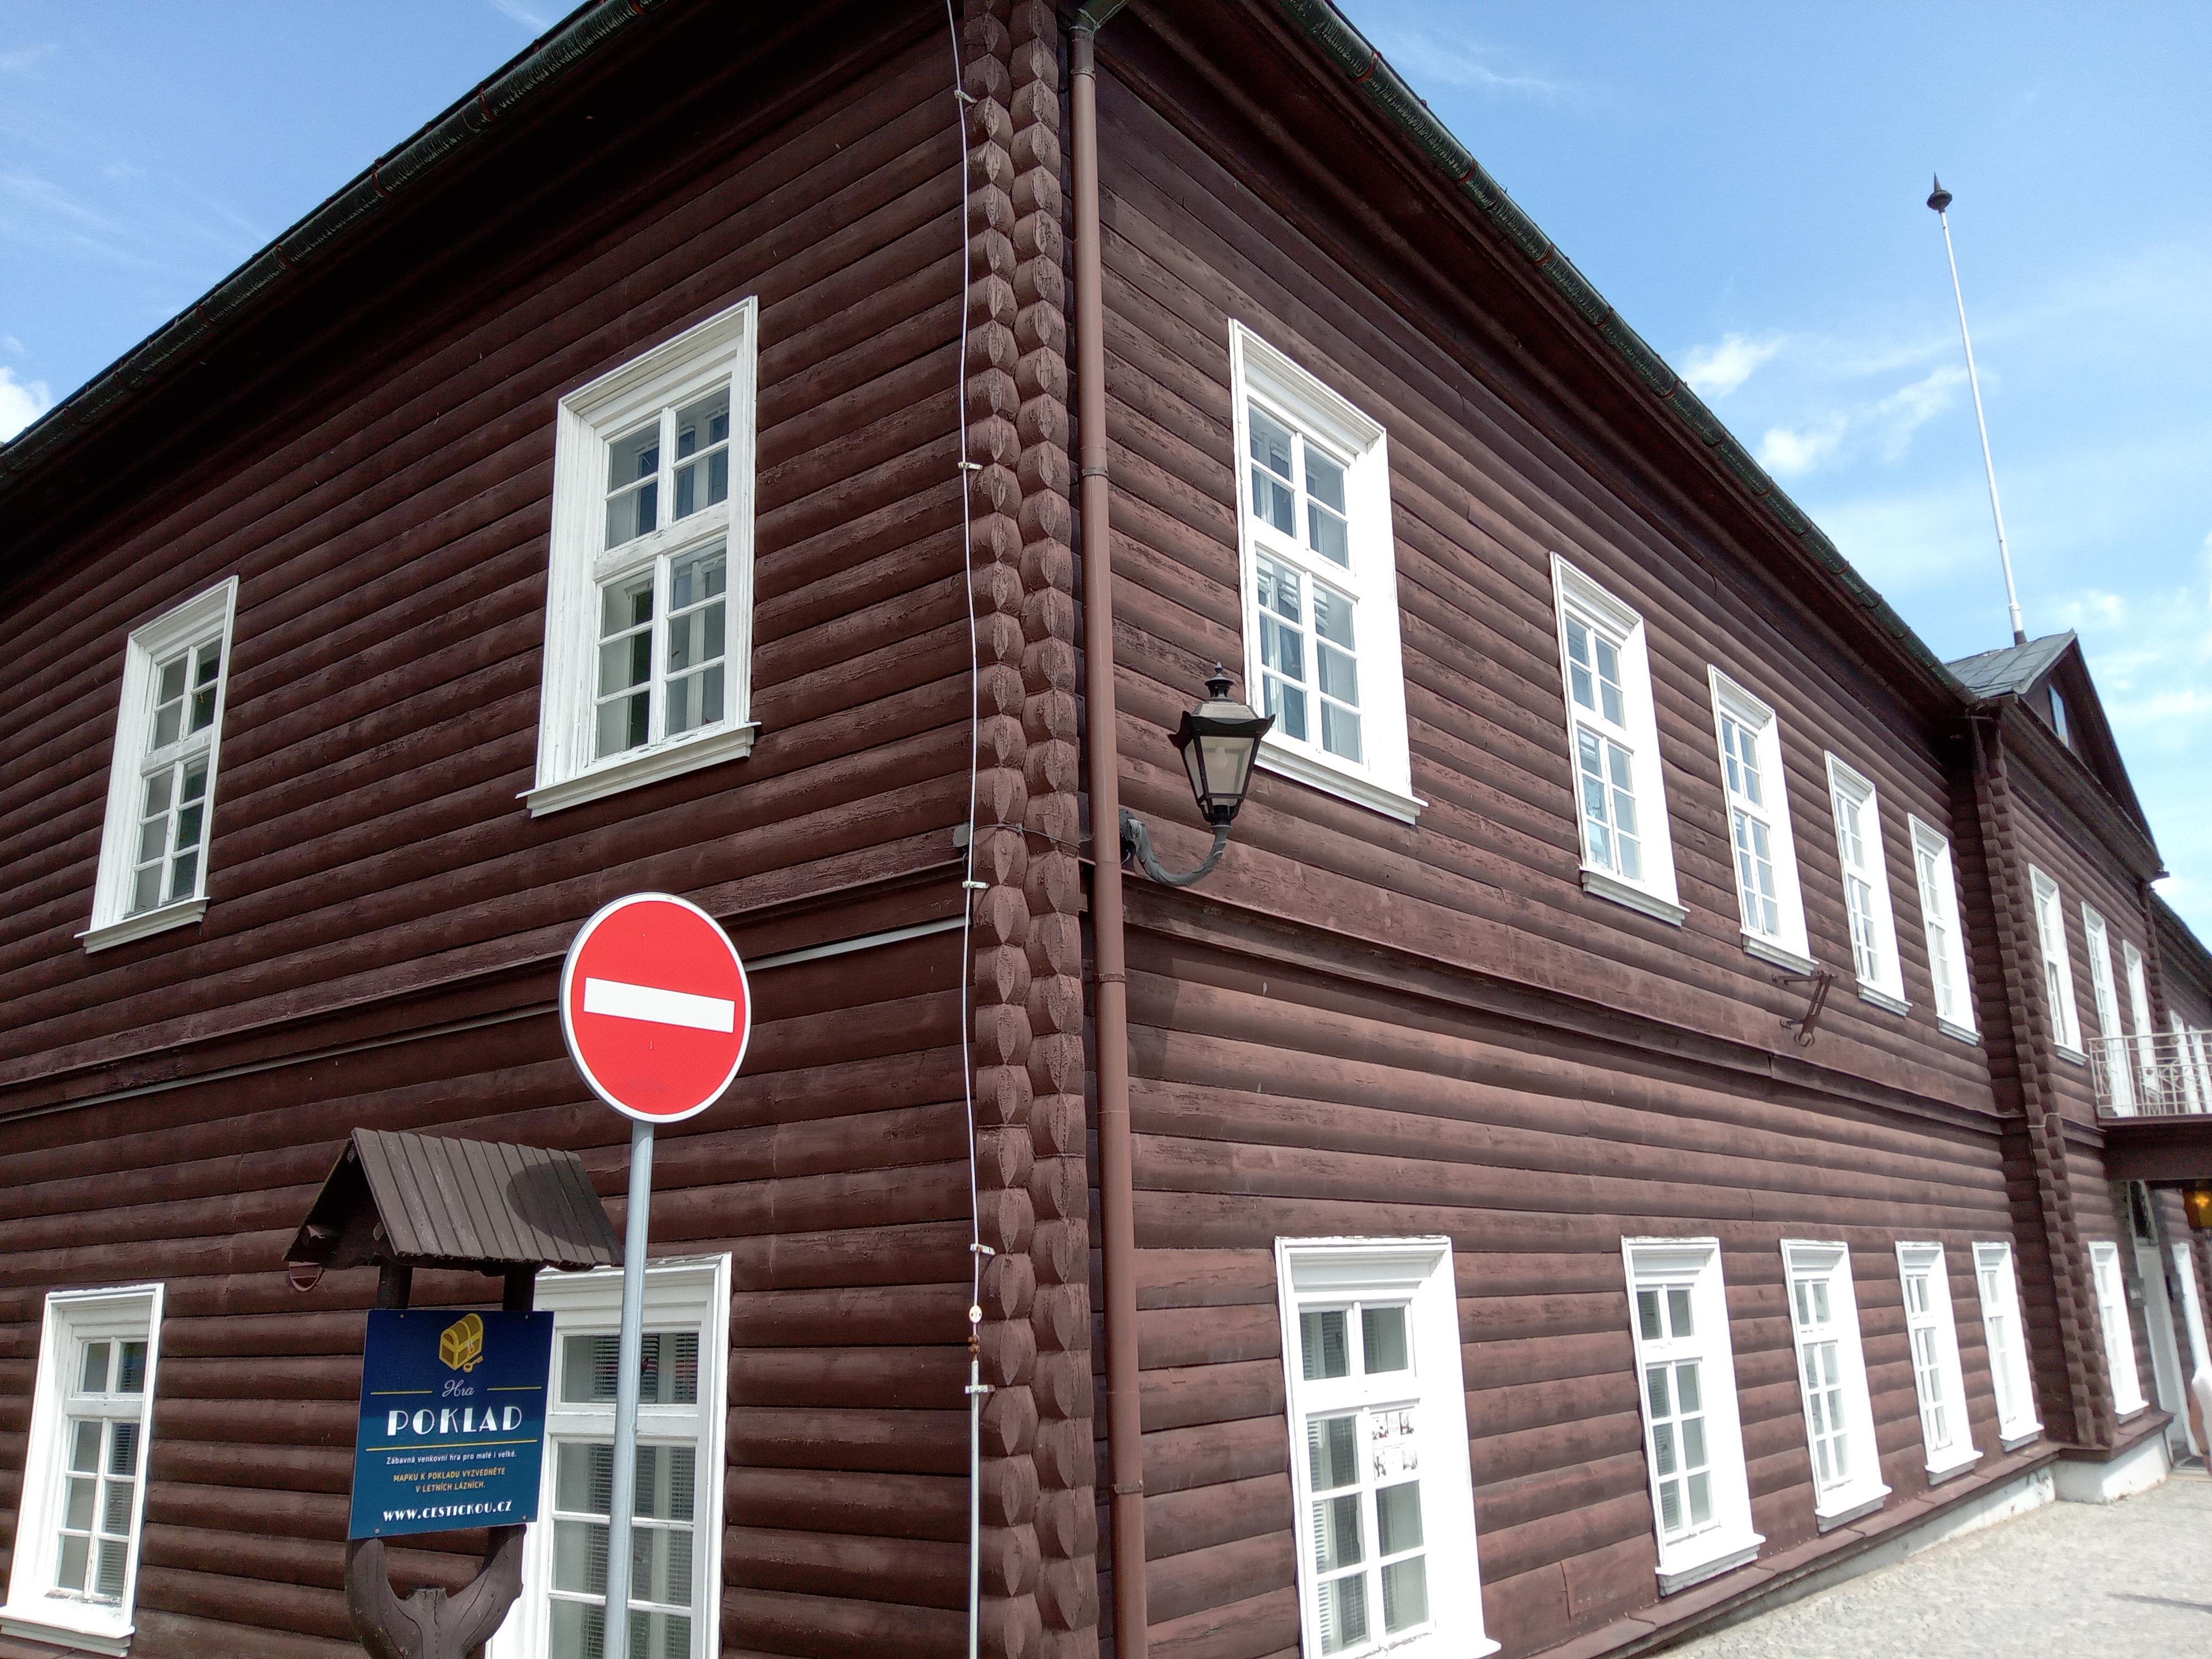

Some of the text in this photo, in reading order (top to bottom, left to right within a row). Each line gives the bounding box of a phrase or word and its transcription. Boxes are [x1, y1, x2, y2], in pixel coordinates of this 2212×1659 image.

[441, 1379, 474, 1397] Hra
[387, 1406, 523, 1437] POKLAD
[386, 1456, 416, 1465] Zábavná
[418, 1454, 447, 1463] venkovní
[450, 1453, 461, 1461] hra
[462, 1453, 474, 1462] pro
[476, 1451, 492, 1459] malé
[498, 1449, 517, 1458] velké.
[393, 1467, 505, 1483] MAPKU K POKLADU VYZVEDNĚTE
[422, 1481, 452, 1493] LETNÍCH
[455, 1480, 486, 1490] LÁZNÍCH.
[383, 1500, 513, 1521] WWW.CESTICKOU.CZ
